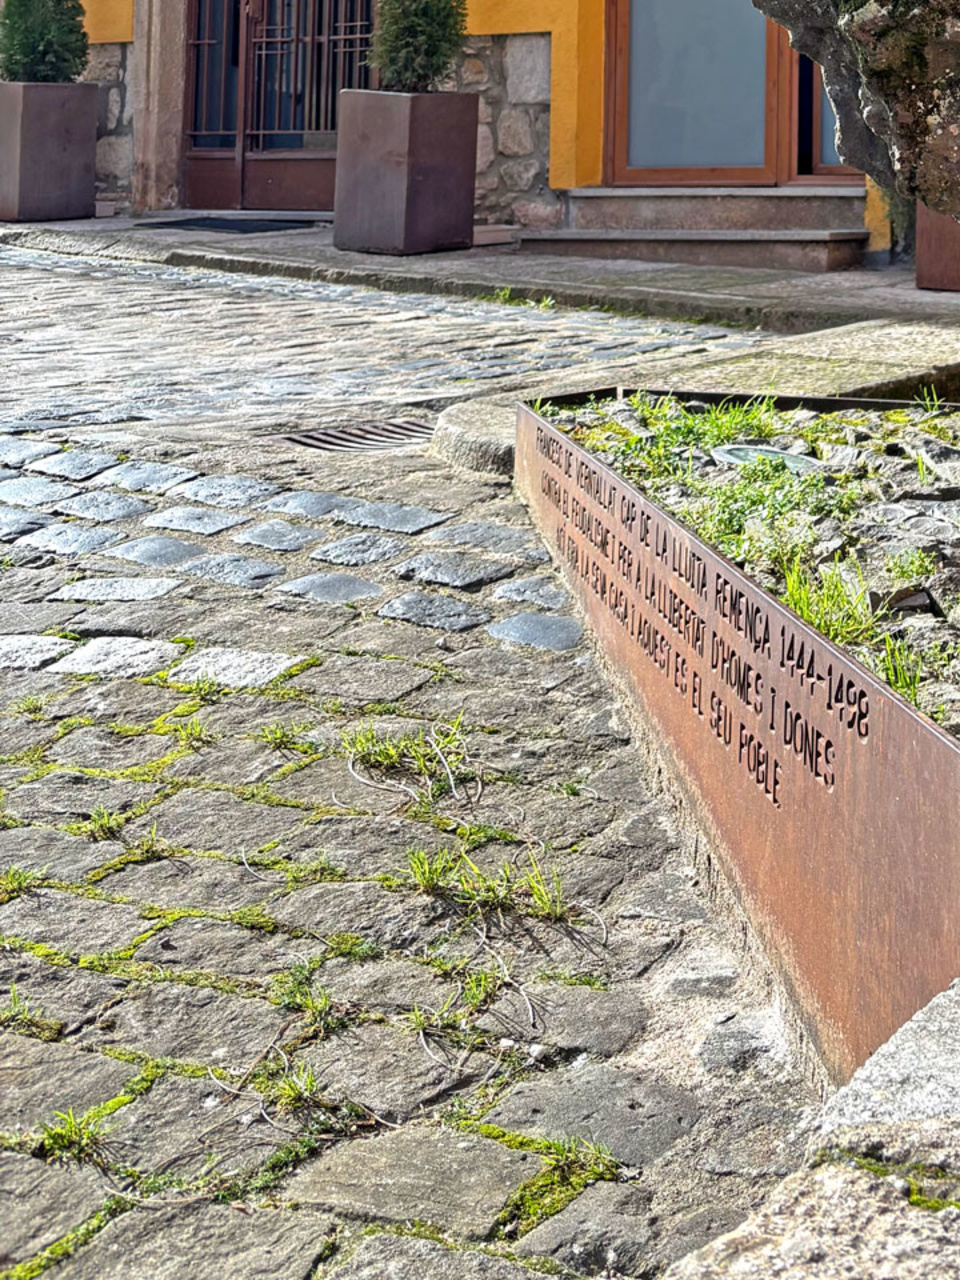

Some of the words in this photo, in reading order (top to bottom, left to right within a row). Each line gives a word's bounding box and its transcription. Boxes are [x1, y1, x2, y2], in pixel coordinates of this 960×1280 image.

[536, 426, 563, 469] FRANCESC
[564, 448, 573, 478] DE
[576, 457, 616, 517] VERNTALLAT
[621, 495, 636, 532] CAP
[640, 510, 651, 547] DE
[655, 522, 667, 565] LA
[673, 537, 707, 601] LLUITA
[715, 572, 771, 660] REMENÇA
[780, 625, 869, 740] 1444-1498
[563, 489, 569, 519] EL
[618, 541, 632, 583] PER
[635, 559, 641, 593] A
[645, 566, 655, 608] LA
[658, 579, 706, 658] LLIBERTAT
[711, 630, 763, 715] D'HOMES
[769, 686, 777, 730] I
[783, 700, 835, 790] DONES
[581, 550, 589, 584] LA
[591, 561, 607, 605] SEVA
[609, 581, 628, 631] CASA
[637, 612, 672, 678] AQUEST
[674, 651, 688, 695] ES
[692, 671, 703, 716] EL
[710, 691, 732, 746] SEU
